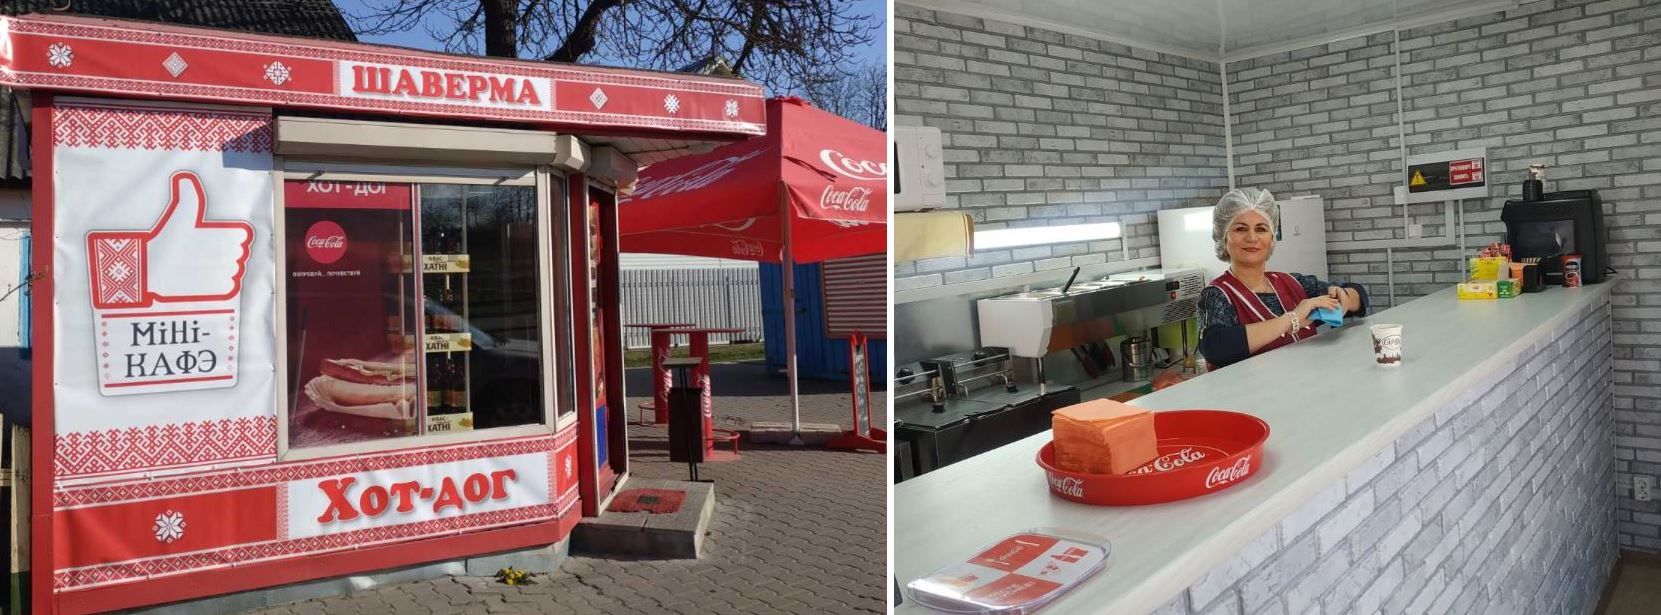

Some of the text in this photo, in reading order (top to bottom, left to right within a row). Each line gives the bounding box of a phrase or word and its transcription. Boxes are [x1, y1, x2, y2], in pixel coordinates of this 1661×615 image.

[352, 65, 542, 106] ШАВЕРМА
[819, 149, 887, 180] Coc
[820, 185, 873, 211] Coca-Cola
[307, 235, 345, 248] Coca-Cola
[124, 349, 218, 378] КАФЭ
[1205, 454, 1252, 489] Coca-Cola
[316, 468, 518, 524] Хот-дог
